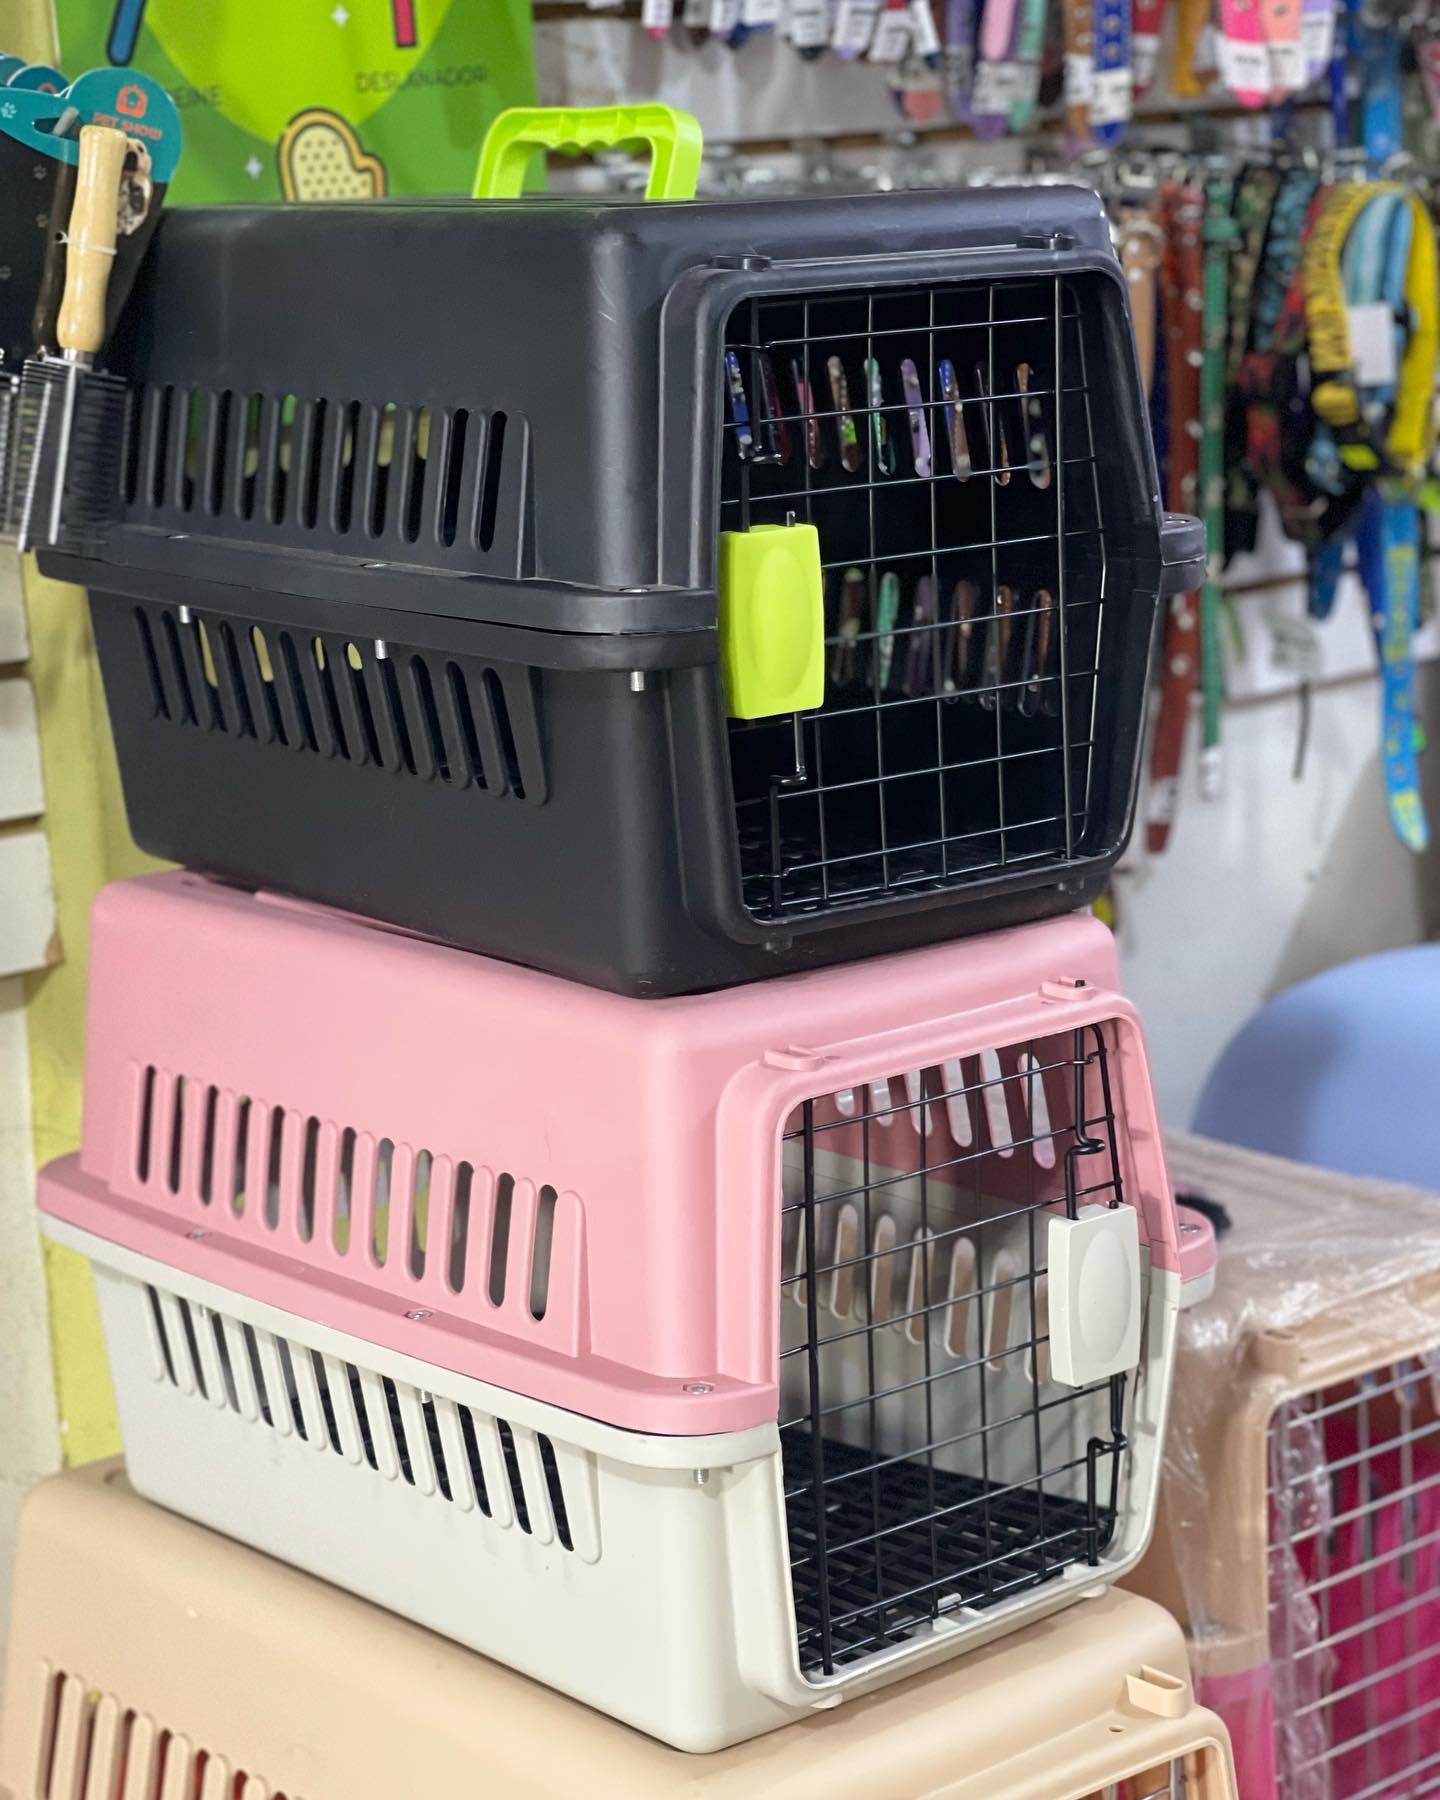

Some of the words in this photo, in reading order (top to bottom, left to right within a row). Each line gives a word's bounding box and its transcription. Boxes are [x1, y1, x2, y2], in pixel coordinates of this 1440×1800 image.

[173, 84, 223, 109] EINE
[92, 112, 119, 128] PET
[121, 120, 163, 141] SHOW
